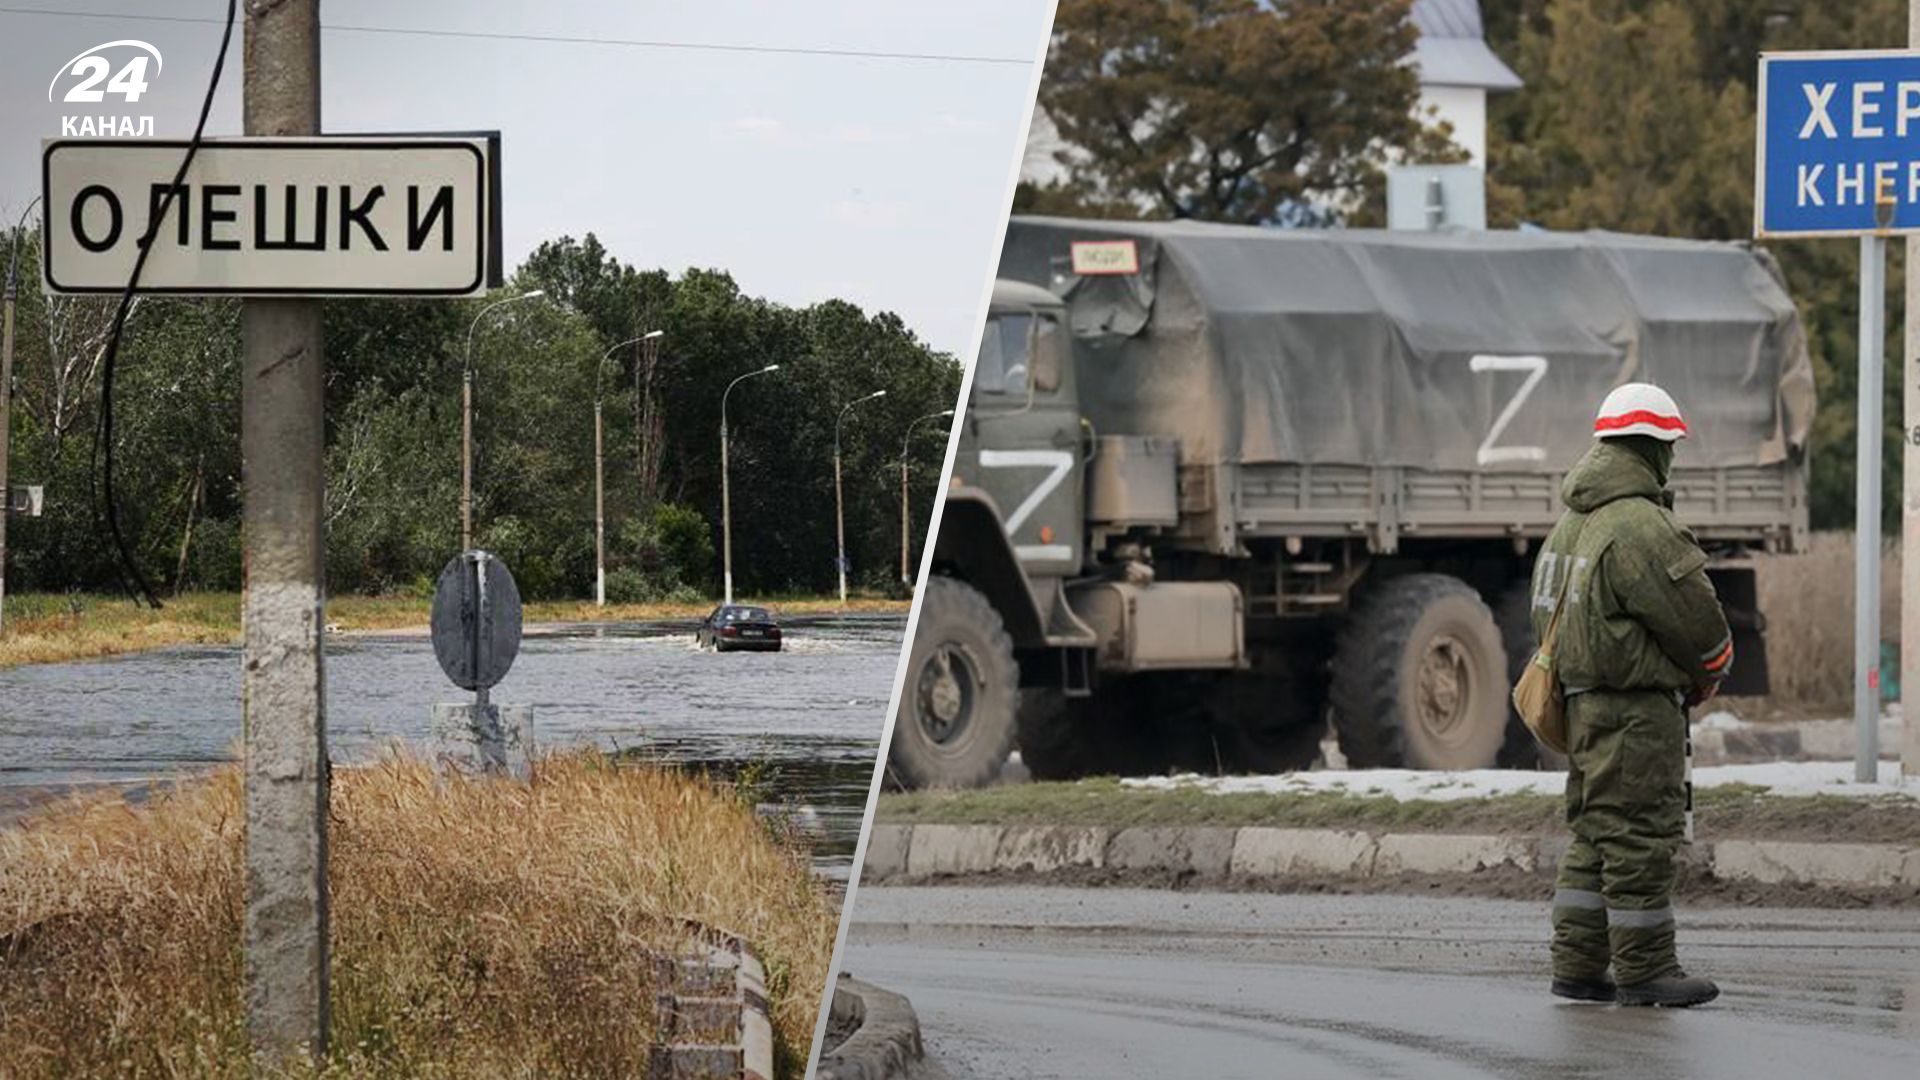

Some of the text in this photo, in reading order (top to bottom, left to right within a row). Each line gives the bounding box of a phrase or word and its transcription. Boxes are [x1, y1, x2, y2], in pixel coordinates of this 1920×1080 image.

[70, 183, 454, 253] ОЛЕШКИ
[1470, 354, 1547, 465] Z
[979, 450, 1074, 560] Z
